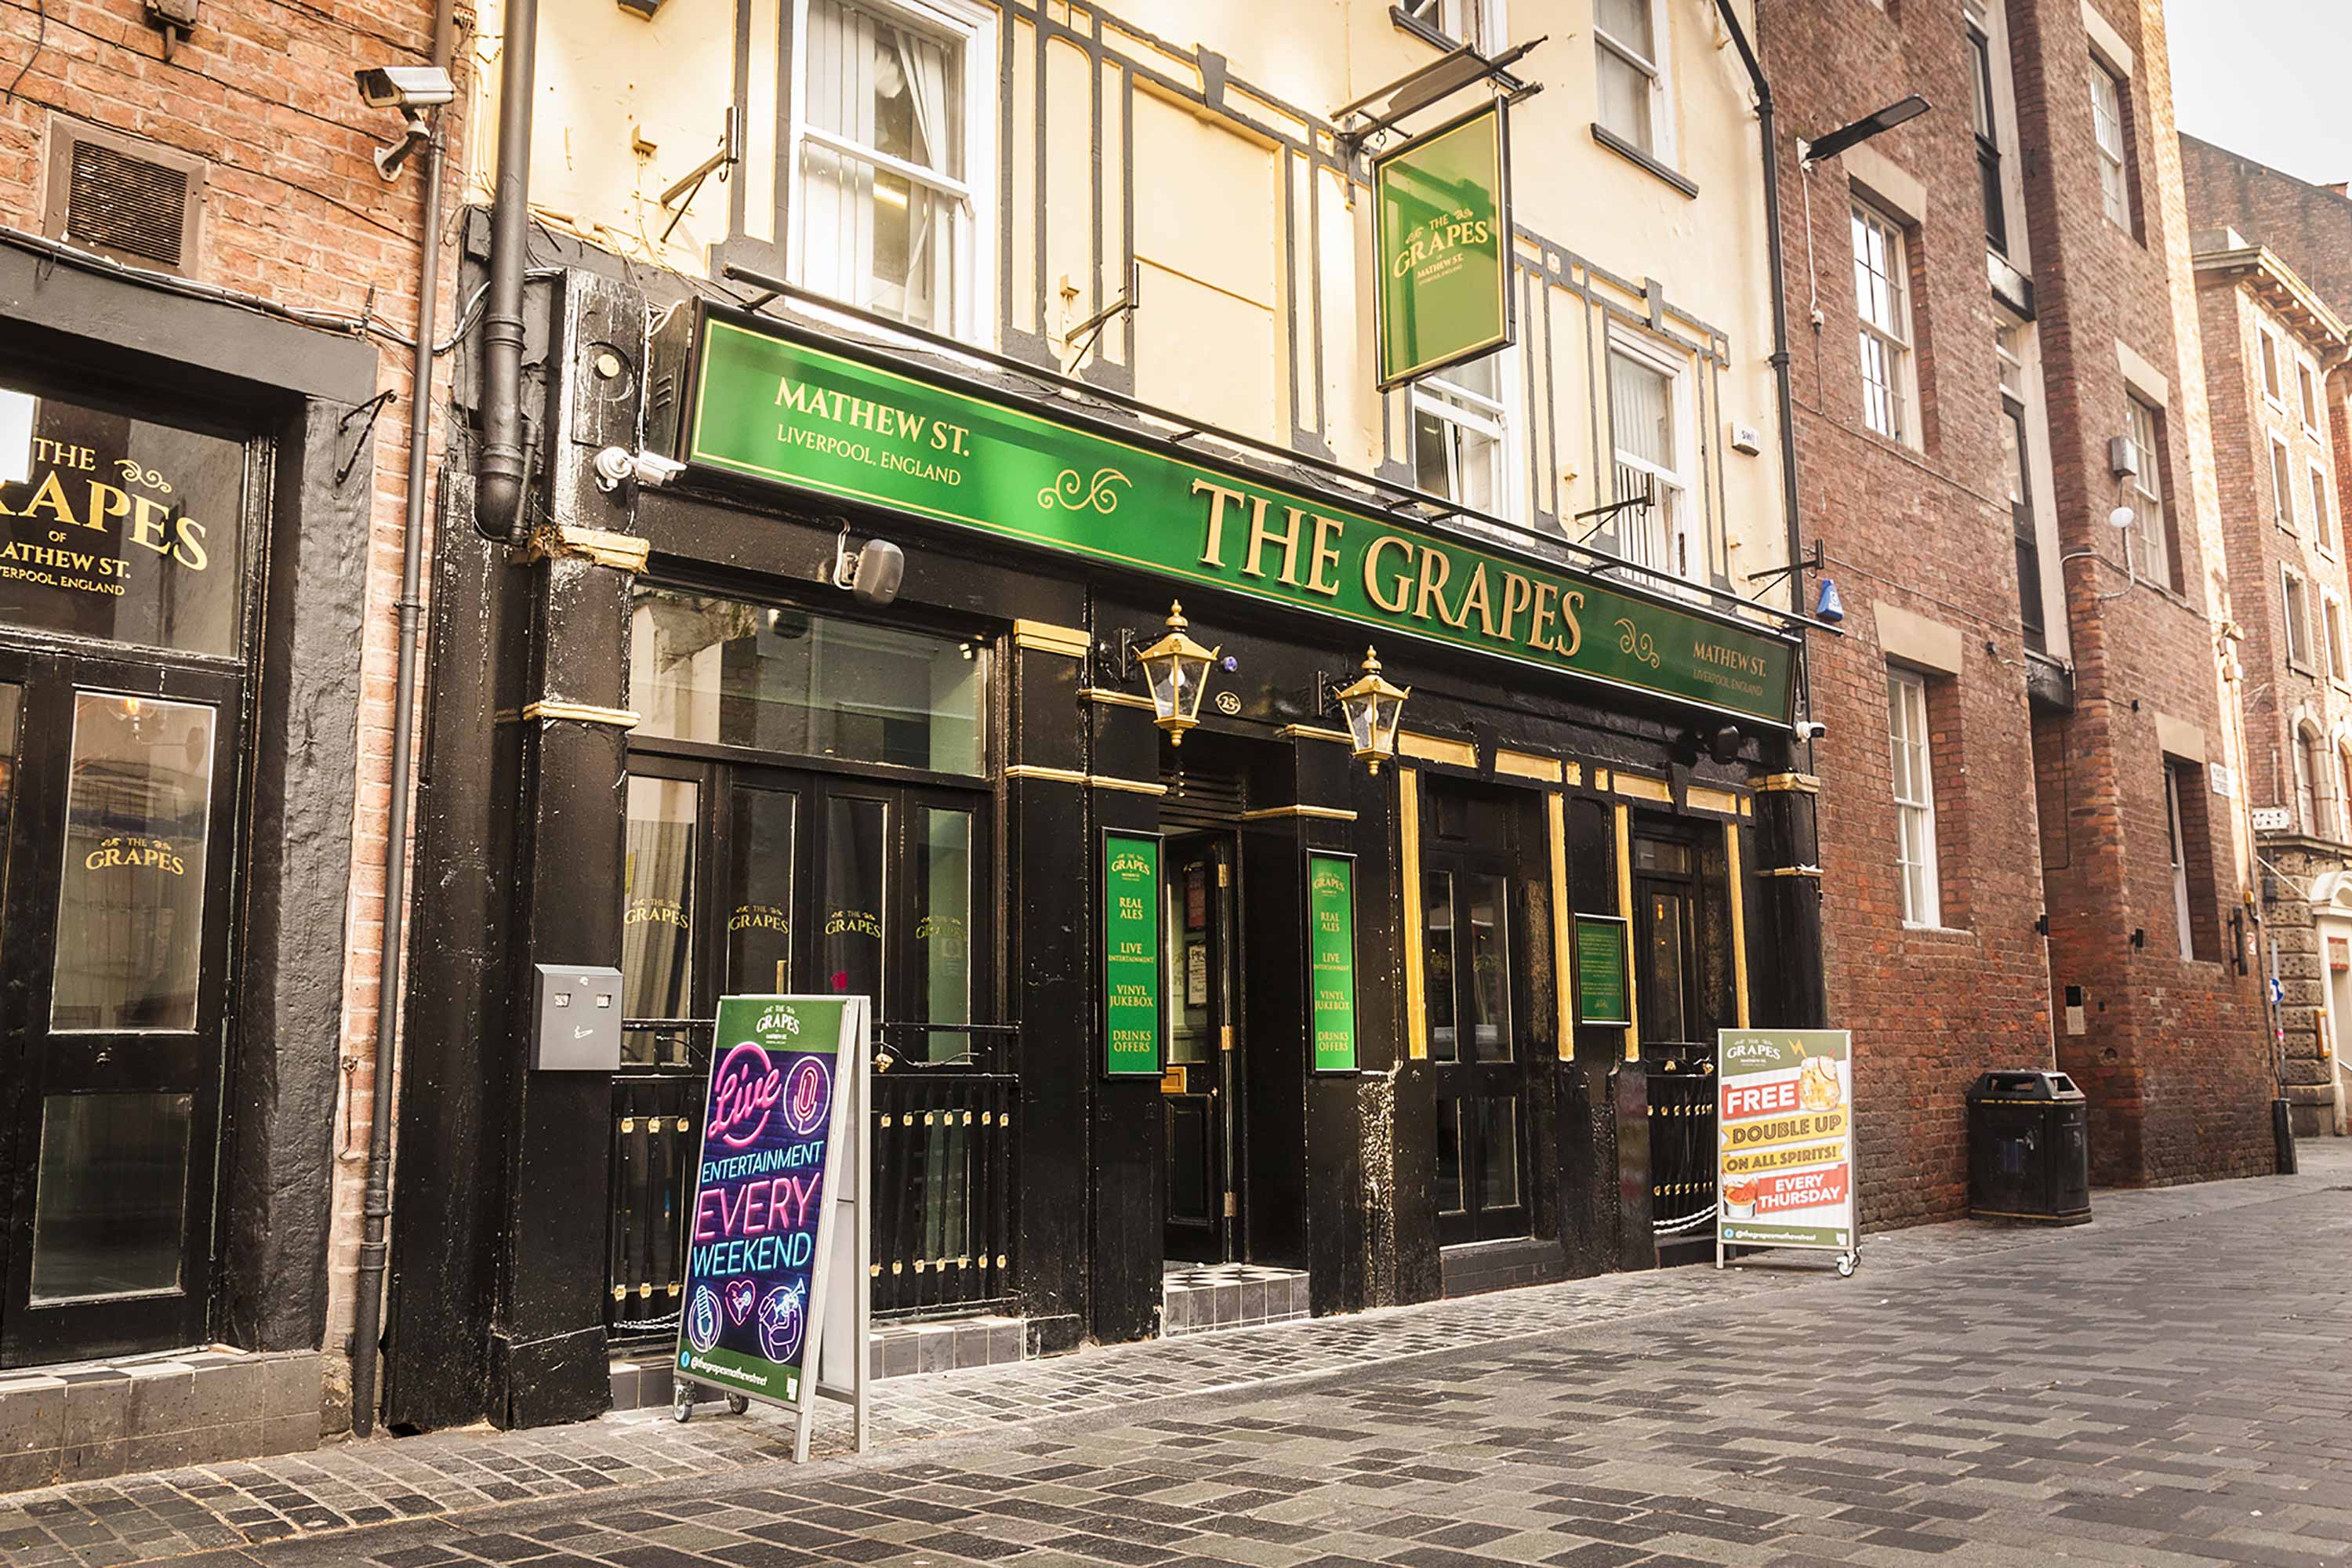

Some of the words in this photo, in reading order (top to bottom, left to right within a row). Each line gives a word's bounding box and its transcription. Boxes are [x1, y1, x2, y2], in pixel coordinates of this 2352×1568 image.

[1429, 214, 1449, 231] THE
[1393, 220, 1488, 278] GRAPES
[775, 377, 925, 443] MATHEW
[931, 420, 970, 457] ST.
[32, 437, 96, 470] THE
[880, 451, 961, 486] ENGLAND
[0, 470, 207, 571] APES
[48, 531, 67, 543] OF
[0, 541, 94, 572] ATHEW
[99, 557, 131, 579] ST.
[1192, 477, 1344, 596] THE
[1364, 535, 1584, 657] GRAPES
[0, 565, 57, 586] ERPOOL,
[60, 576, 125, 596] ENGLAND
[1693, 640, 1749, 670] MATHEW
[1751, 656, 1768, 677] ST.
[1221, 695, 1236, 710] 25
[126, 837, 147, 848] THE
[85, 849, 184, 875] GRAPES
[1112, 859, 1150, 876] GRAPES
[1120, 897, 1142, 909] REAL
[624, 908, 688, 928] GRAPES
[1120, 909, 1142, 920] ALES
[1321, 912, 1339, 922] REAL
[729, 914, 789, 934] GRAPES
[825, 919, 881, 938] GRAPES
[1322, 923, 1340, 932] ALES
[1121, 942, 1142, 954] LIVE
[1323, 953, 1340, 964] LIVE
[1116, 985, 1146, 995] VINYL
[1320, 991, 1345, 1000] VINYL
[1110, 996, 1153, 1007] JUKEBOX
[1315, 1000, 1349, 1011] JUKEBOX
[756, 1014, 800, 1035] GRAPES
[1113, 1030, 1152, 1041] DRINKS
[1318, 1031, 1348, 1042] DRINKS
[1114, 1042, 1150, 1052] OFFERS
[1319, 1042, 1348, 1052] OFFERS
[1727, 1044, 1781, 1060] GRAPES
[1726, 1083, 1795, 1115] FREE
[1733, 1119, 1809, 1144] DOUBLE
[1815, 1113, 1842, 1133] UP
[701, 1141, 824, 1183] ENTERTAINMENT
[1726, 1157, 1748, 1171] ON
[1752, 1153, 1777, 1168] ALL
[1780, 1145, 1836, 1165] SPIRITS!
[1775, 1174, 1824, 1192] EVERY
[1759, 1186, 1841, 1208] THURSDAY
[695, 1172, 820, 1241] EVERY
[693, 1232, 812, 1278] WEEKEND
